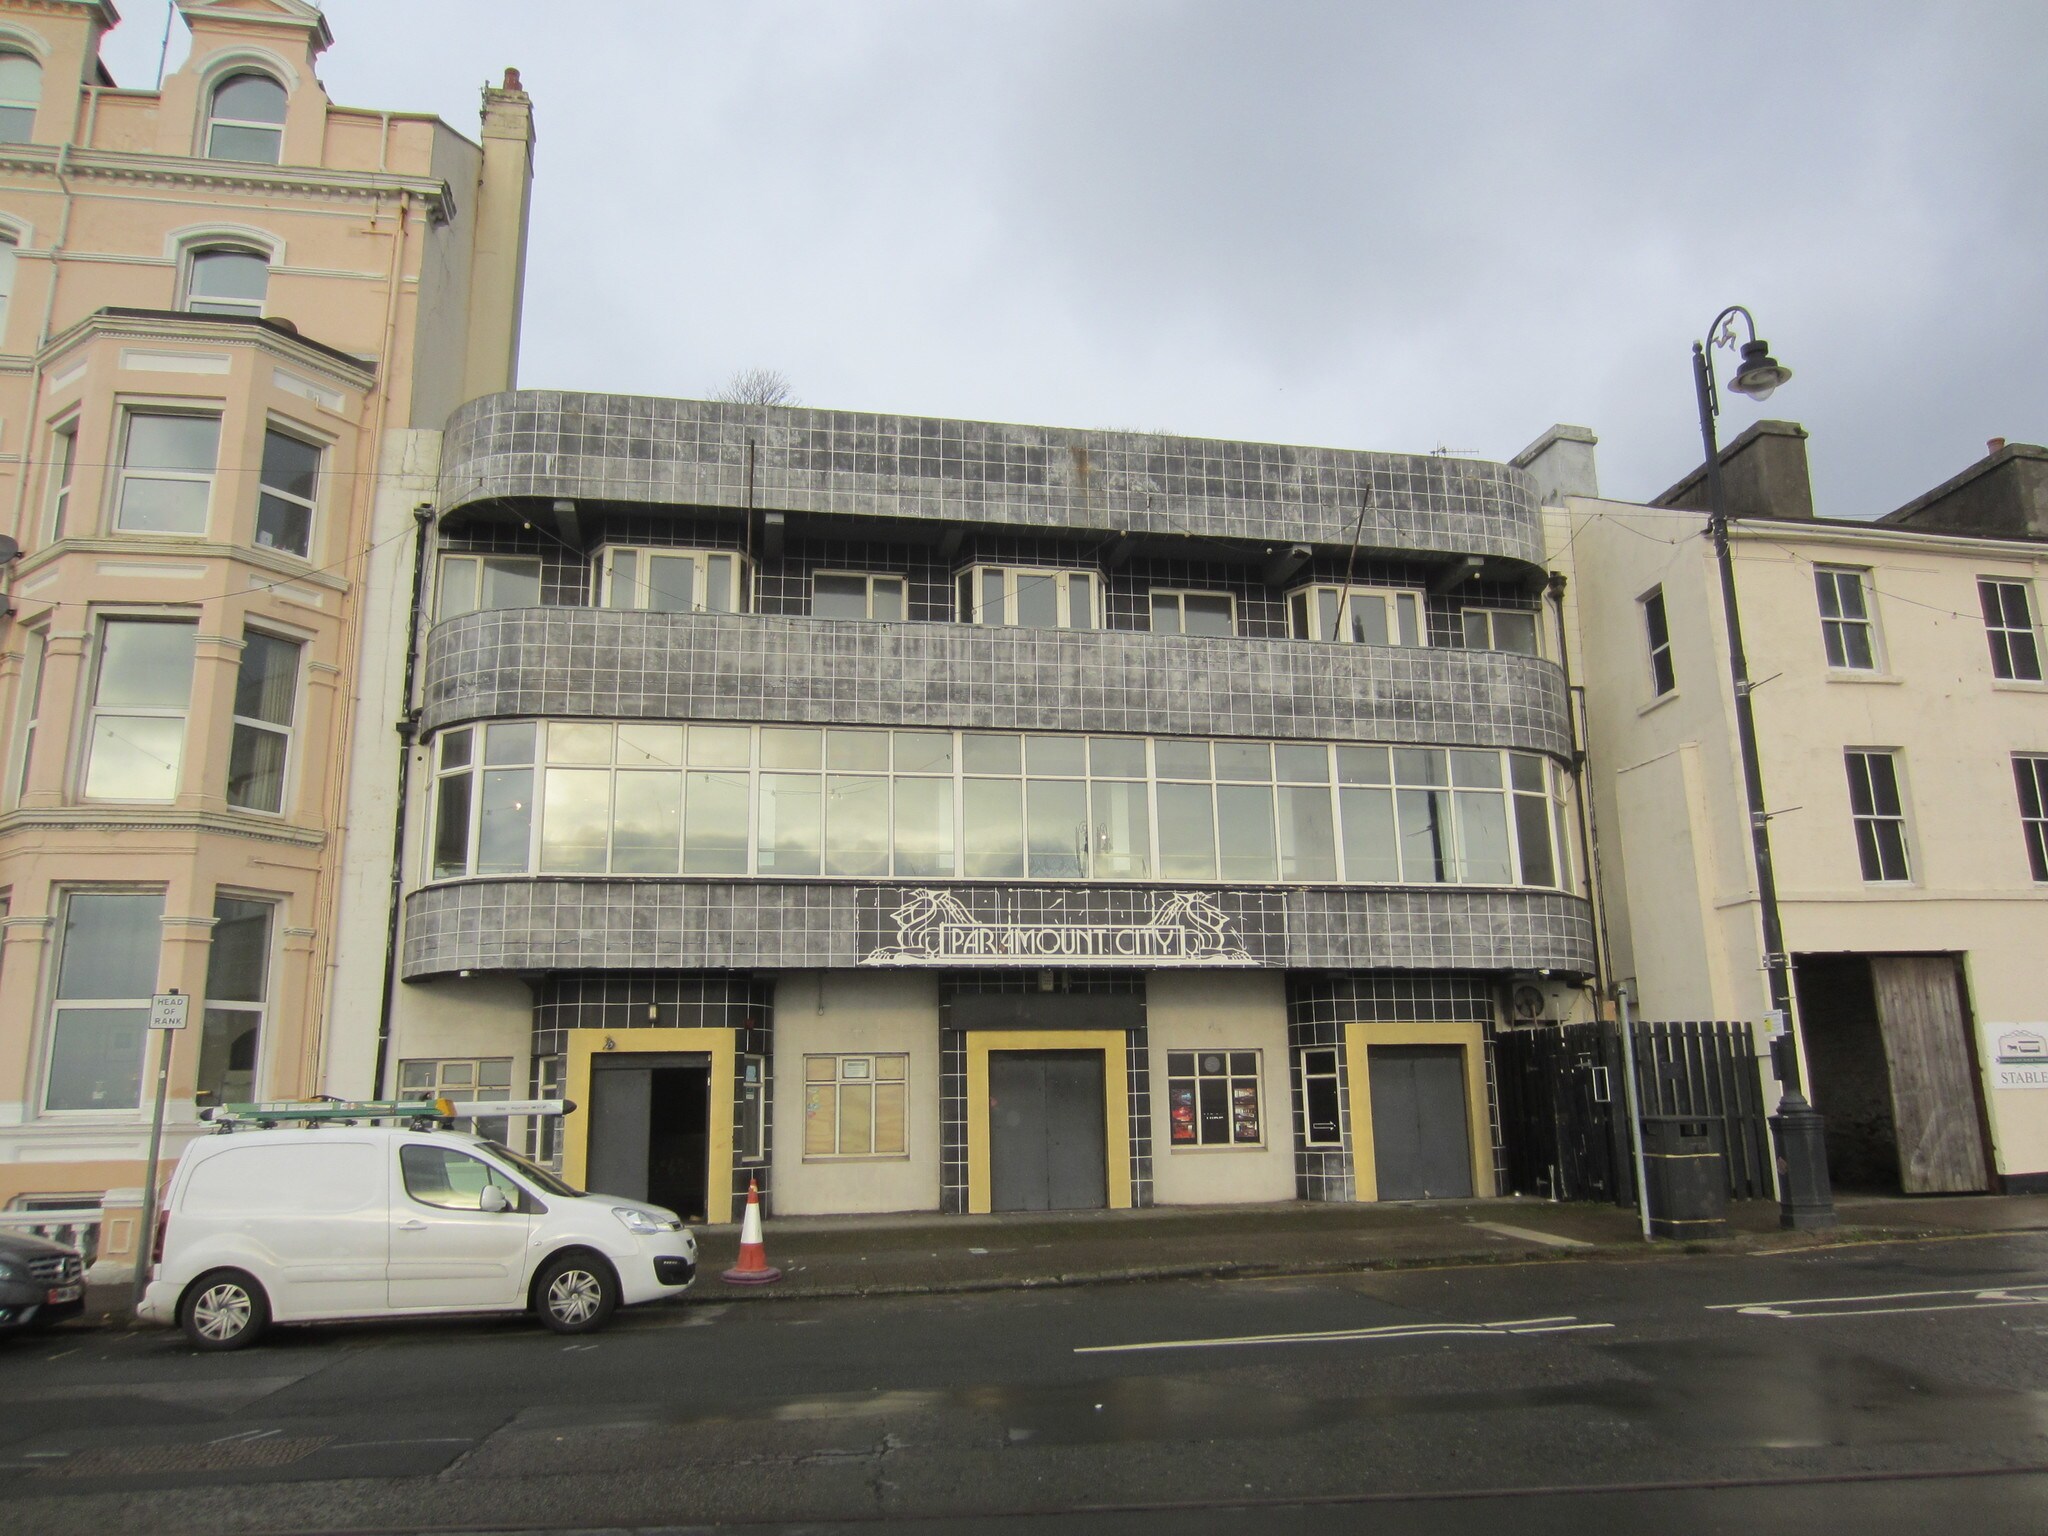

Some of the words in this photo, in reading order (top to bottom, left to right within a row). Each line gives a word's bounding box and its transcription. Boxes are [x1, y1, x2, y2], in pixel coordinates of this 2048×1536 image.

[952, 928, 1107, 955] PARAMOUNT
[1115, 929, 1174, 955] CITY
[157, 998, 184, 1006] HEAD
[154, 1017, 182, 1025] RANK
[2000, 1071, 2048, 1084] STABLE
